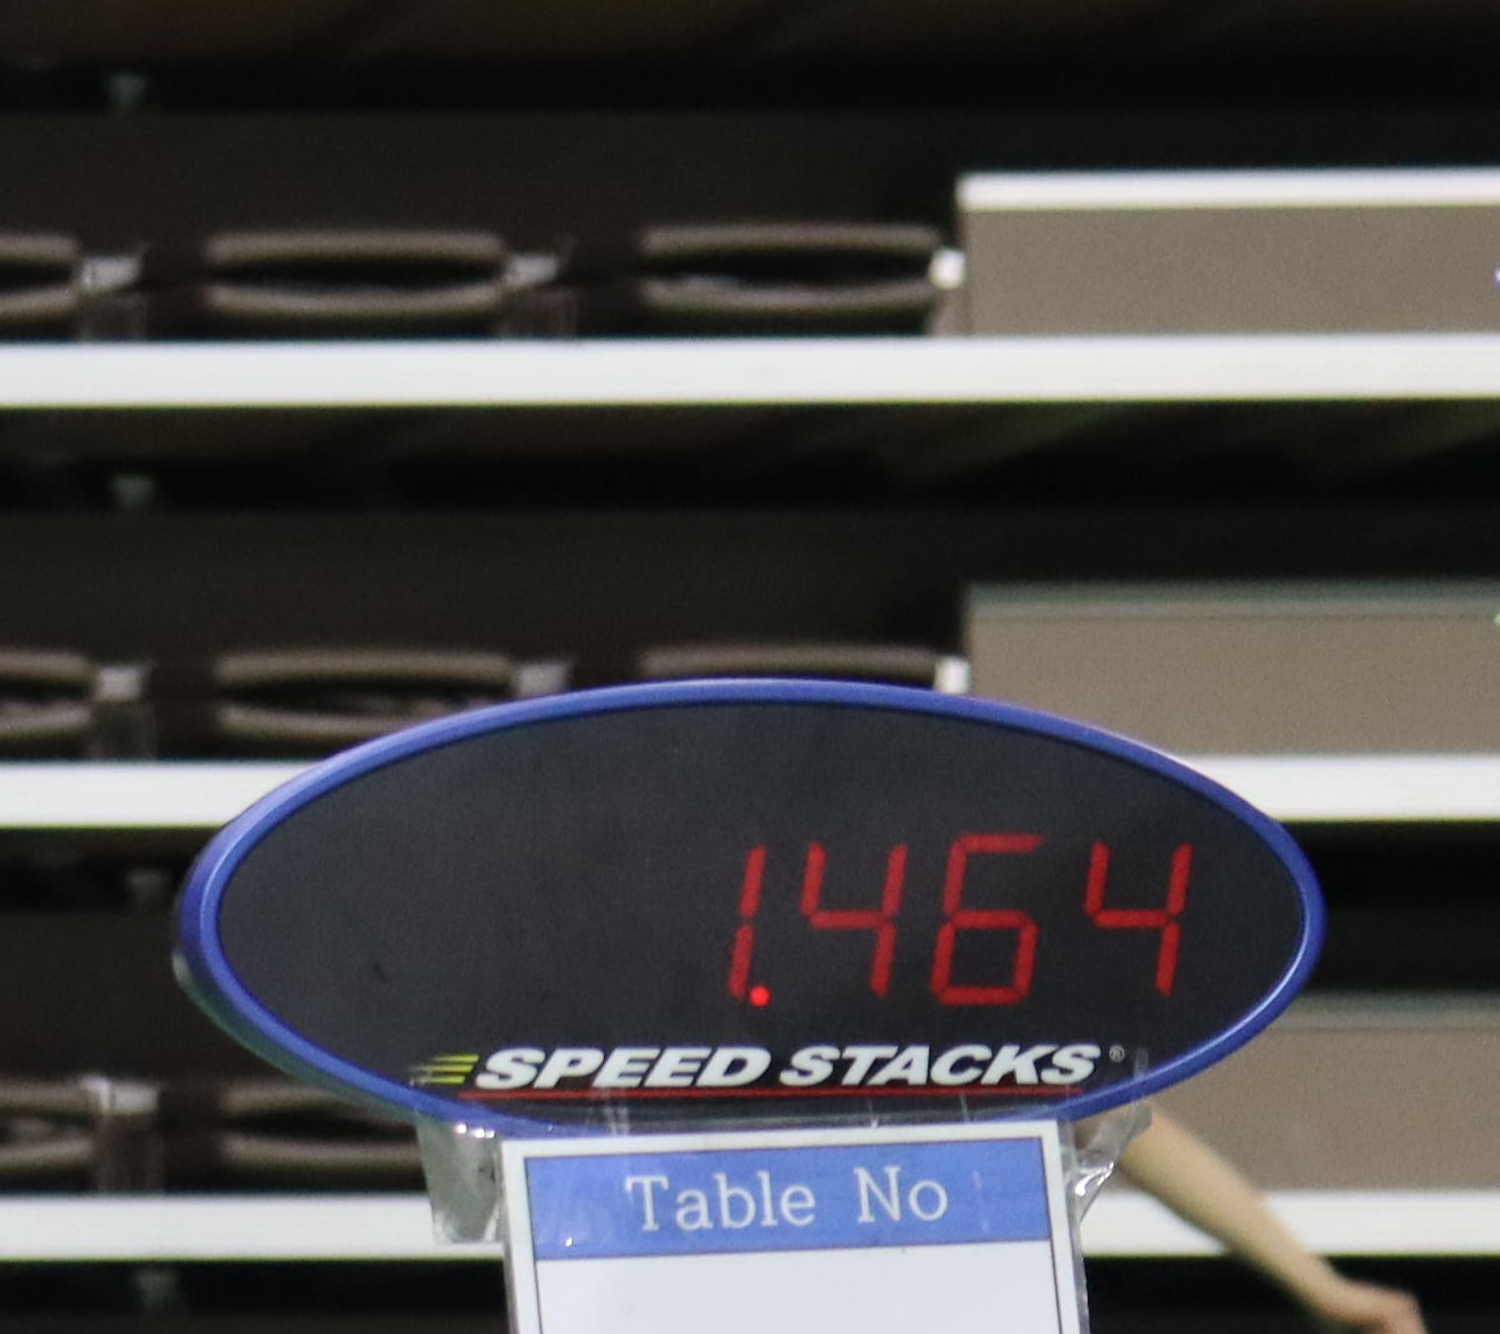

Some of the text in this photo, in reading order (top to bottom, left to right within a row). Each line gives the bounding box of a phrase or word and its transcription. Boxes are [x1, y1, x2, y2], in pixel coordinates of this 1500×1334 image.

[728, 835, 1191, 1004] 1.464
[473, 1045, 770, 1088] SPEED
[626, 1167, 950, 1231] Table No
